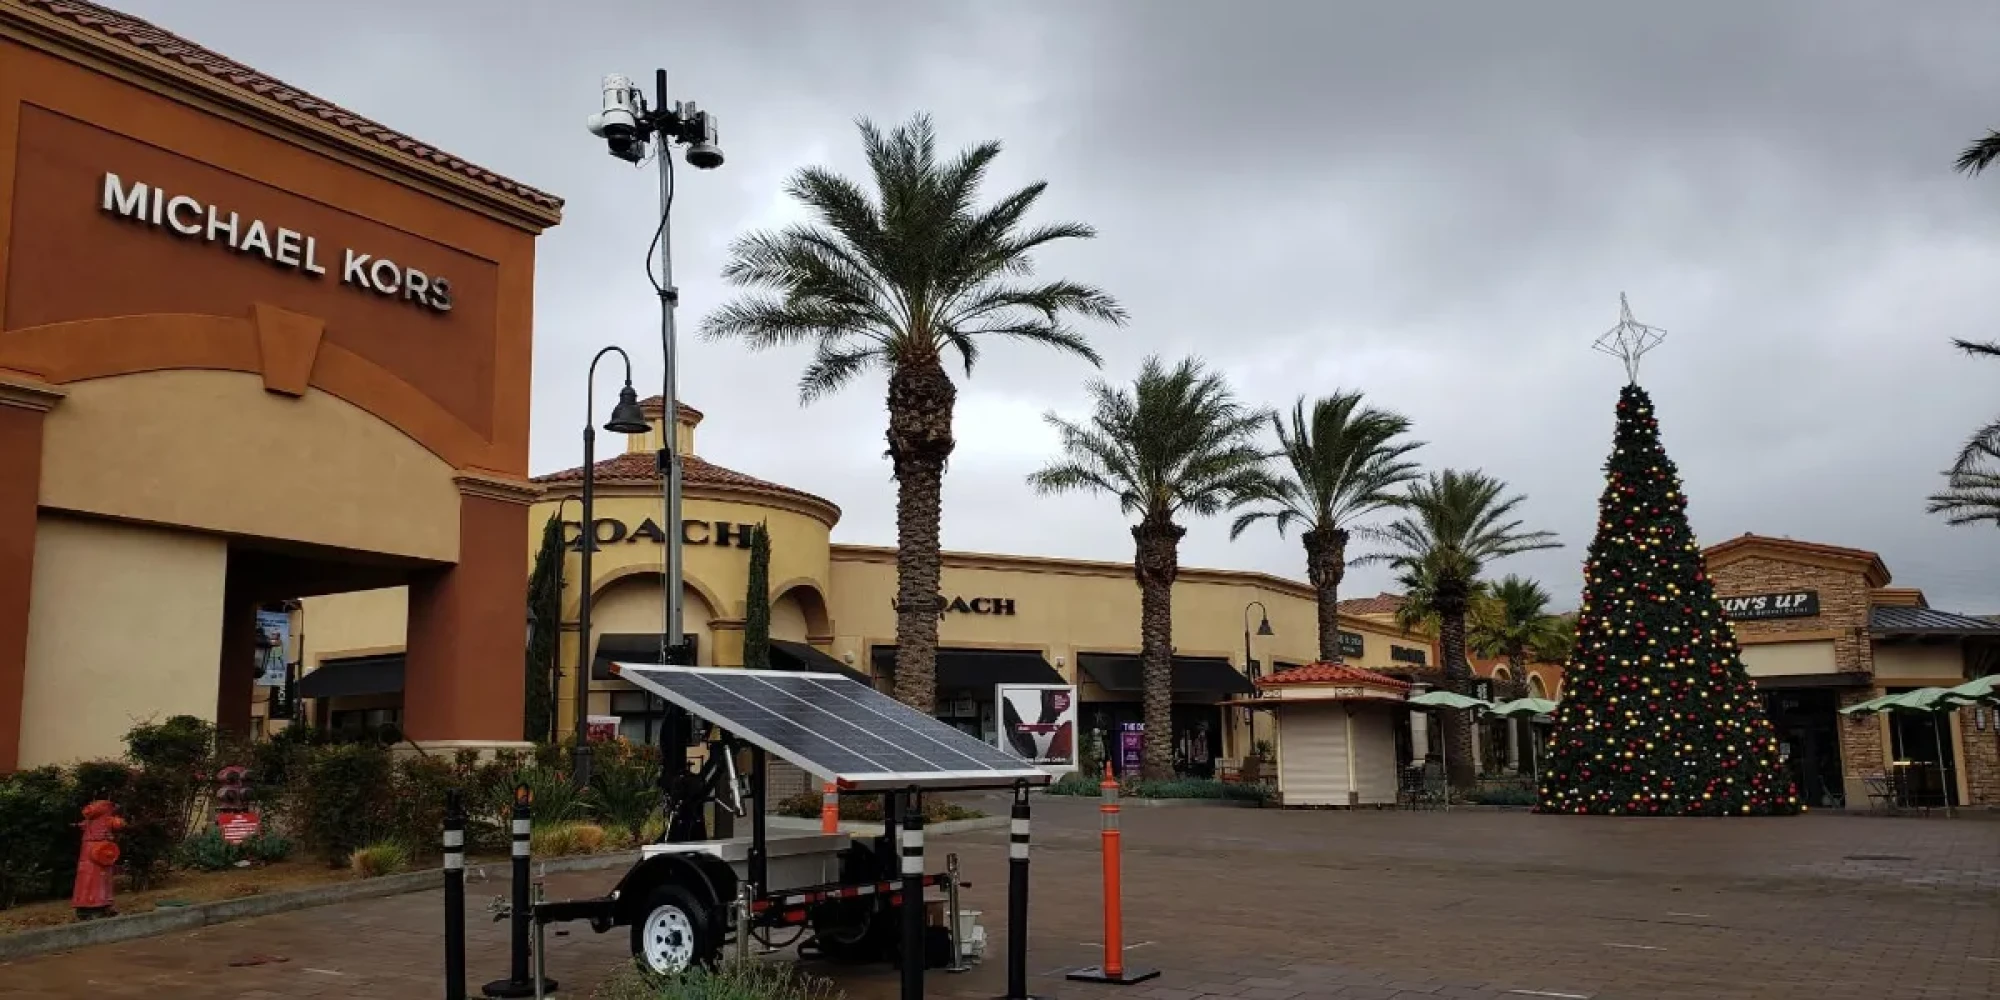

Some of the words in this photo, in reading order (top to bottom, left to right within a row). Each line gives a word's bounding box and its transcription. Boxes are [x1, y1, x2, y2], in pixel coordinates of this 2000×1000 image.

[103, 172, 325, 274] MICHAEL
[344, 248, 453, 311] KORS
[1718, 596, 1768, 611] UN'S
[1774, 594, 1808, 608] UP
